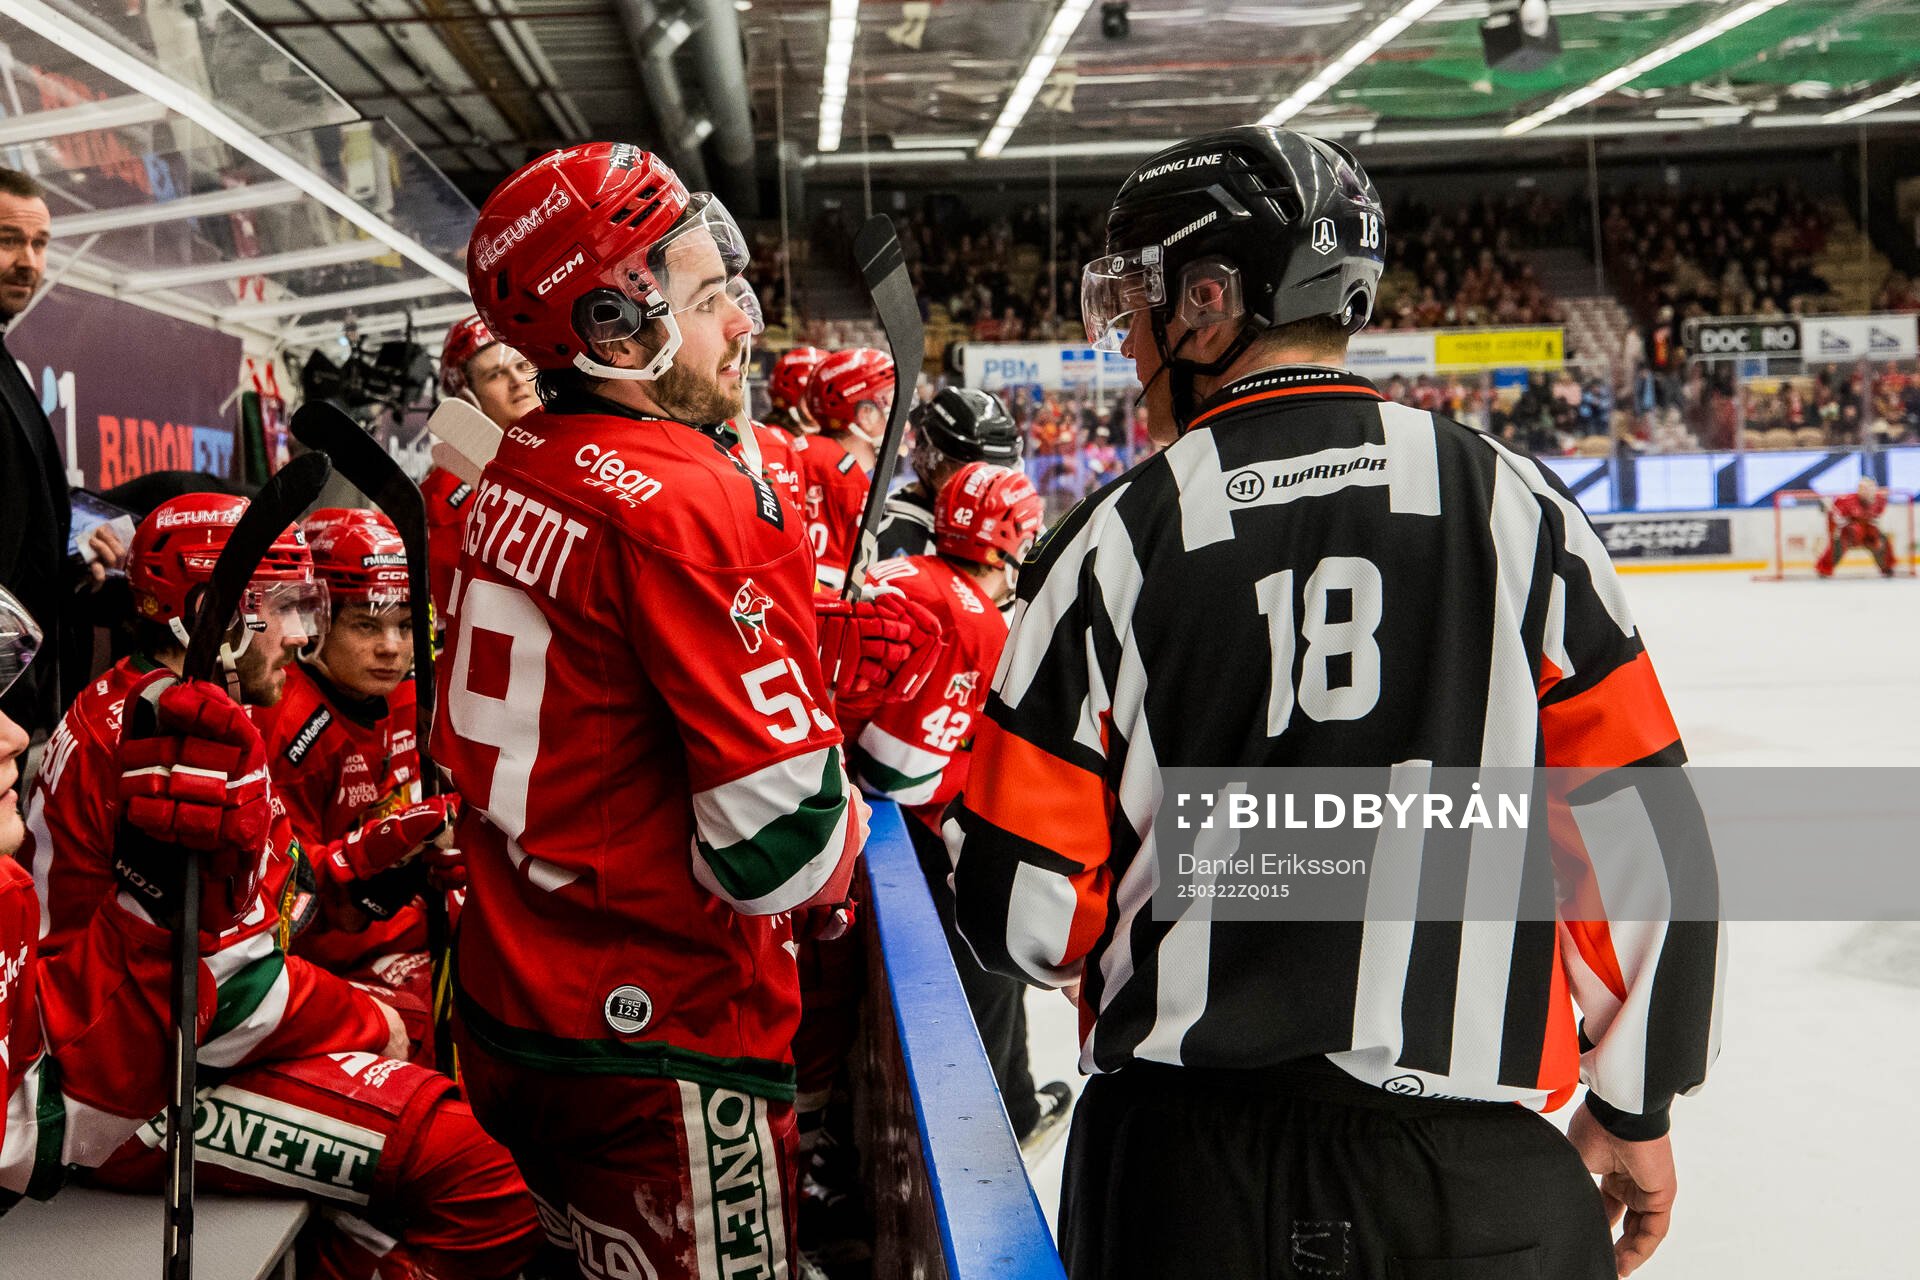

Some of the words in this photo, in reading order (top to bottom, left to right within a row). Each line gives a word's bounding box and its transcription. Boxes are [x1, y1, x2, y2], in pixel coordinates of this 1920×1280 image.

[1139, 160, 1185, 182] VIKING
[1187, 154, 1223, 168] LINE
[478, 208, 543, 272] FECTUM
[1163, 211, 1218, 247] WARRIOR
[1360, 211, 1379, 250] 18
[537, 252, 585, 296] CCM
[646, 303, 667, 317] CCM
[985, 359, 1039, 380] PBM
[507, 426, 546, 449] CCM
[575, 444, 663, 502] clean
[1272, 457, 1387, 488] WARRIOR
[954, 507, 974, 526] 42
[1255, 556, 1383, 737] 18
[447, 568, 553, 845] 9
[921, 704, 971, 752] 42
[617, 1004, 640, 1018] 125
